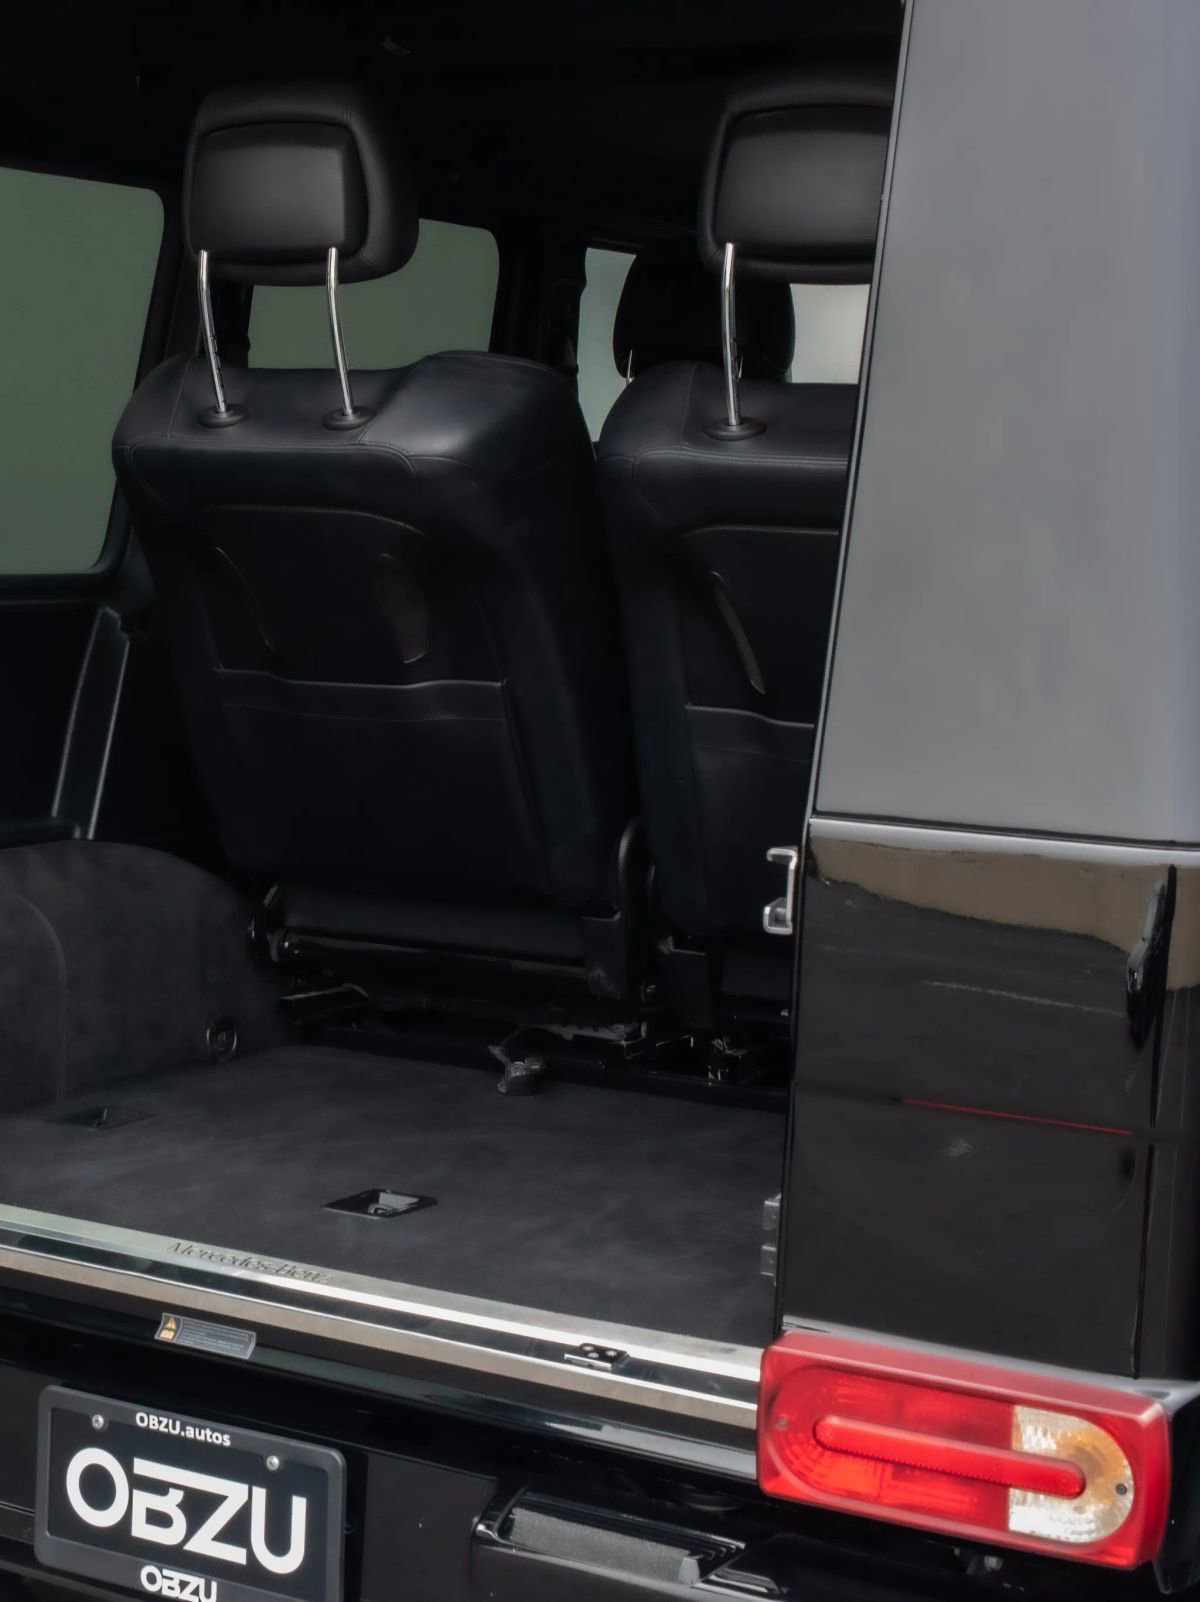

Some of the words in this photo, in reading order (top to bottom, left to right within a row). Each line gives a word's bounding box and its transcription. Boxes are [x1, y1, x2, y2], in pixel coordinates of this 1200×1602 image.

[167, 1242, 333, 1283] Mercedes-Benz
[135, 1411, 231, 1447] OBZU.autos
[65, 1447, 307, 1574] OBZU
[140, 1565, 218, 1602] OBZU
